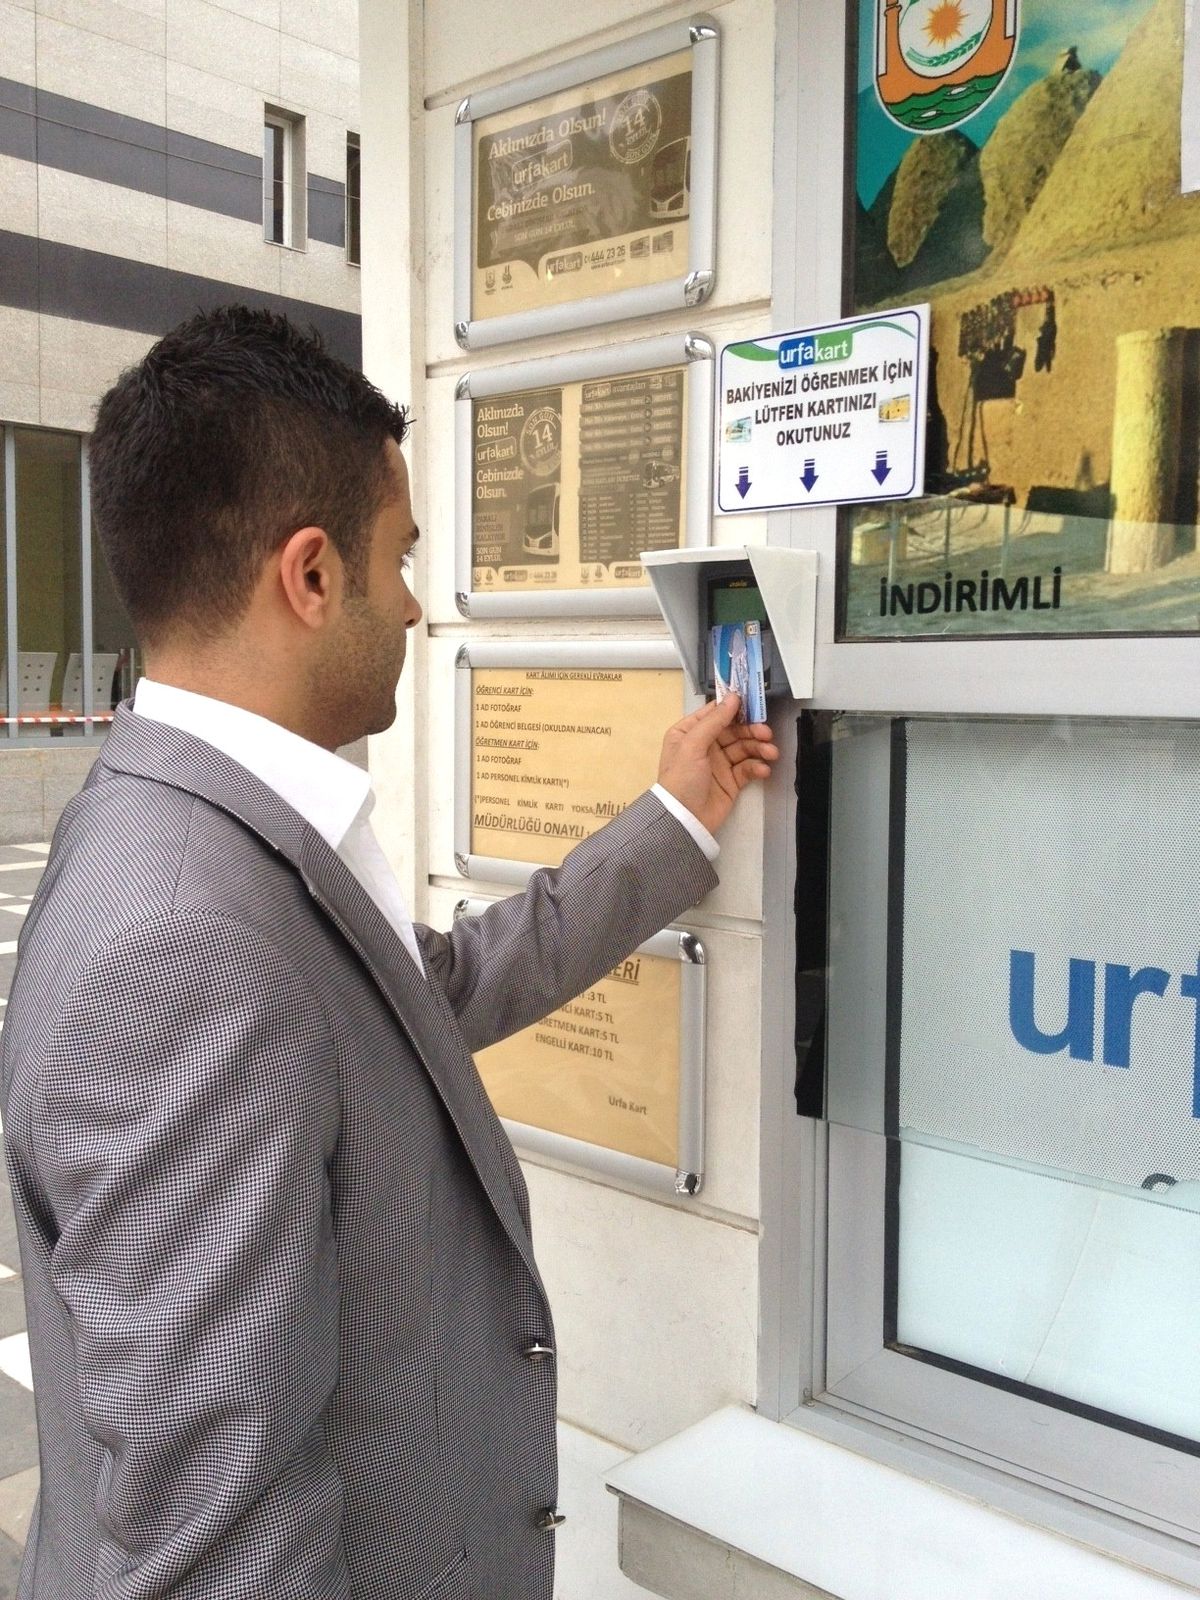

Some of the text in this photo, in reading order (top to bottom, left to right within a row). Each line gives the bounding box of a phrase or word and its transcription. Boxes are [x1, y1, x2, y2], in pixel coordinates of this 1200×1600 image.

[488, 107, 606, 160] Aklınızda Olsun!
[514, 151, 569, 185] urfakart
[487, 192, 548, 222] Cebinizde
[552, 182, 596, 203] Olsun.
[606, 247, 616, 259] 23
[780, 339, 849, 365] urfakart
[726, 358, 913, 404] BAKİYENİZİ ÖĞRENMEK İÇİN
[477, 403, 525, 422] Aklınızda
[755, 392, 877, 425] LÜTFEN KARTINIZI
[477, 421, 509, 438] Olsun!
[532, 423, 553, 449] 14
[776, 422, 851, 446] OKUTUNUZ
[477, 444, 514, 461] urfakart
[476, 466, 524, 483] Cebinizde
[879, 566, 1062, 617] İNDİRİMLİ
[475, 685, 503, 695] ÖĞRENCİ
[503, 687, 519, 695] KART
[490, 702, 522, 713] FOTOĞRAF
[490, 719, 516, 730] ÖĞRENCİ
[517, 722, 541, 731] BELGESİ
[542, 723, 575, 733] (OKULDAN
[576, 726, 612, 736] ALINACAK)
[475, 737, 508, 748] ÖĞRETMEN
[508, 740, 524, 749] KART
[481, 755, 490, 763] AD
[491, 754, 522, 765] FOTOĞRAF
[481, 772, 490, 780] AD
[490, 773, 520, 783] PERSONEL
[521, 775, 542, 785] KİMLİK
[517, 799, 538, 809] KİMLİK
[545, 802, 564, 811] KARTI
[474, 813, 584, 838] MÜDÜRLÜĞÜ ONAYLI
[597, 992, 607, 1004] TL
[604, 1012, 614, 1024] TL
[539, 1017, 576, 1033] RETMEN
[609, 1032, 620, 1044] TL
[535, 1033, 567, 1049] ENGELLİ
[605, 1050, 614, 1061] TL
[608, 1095, 648, 1116] Urfa Kart
